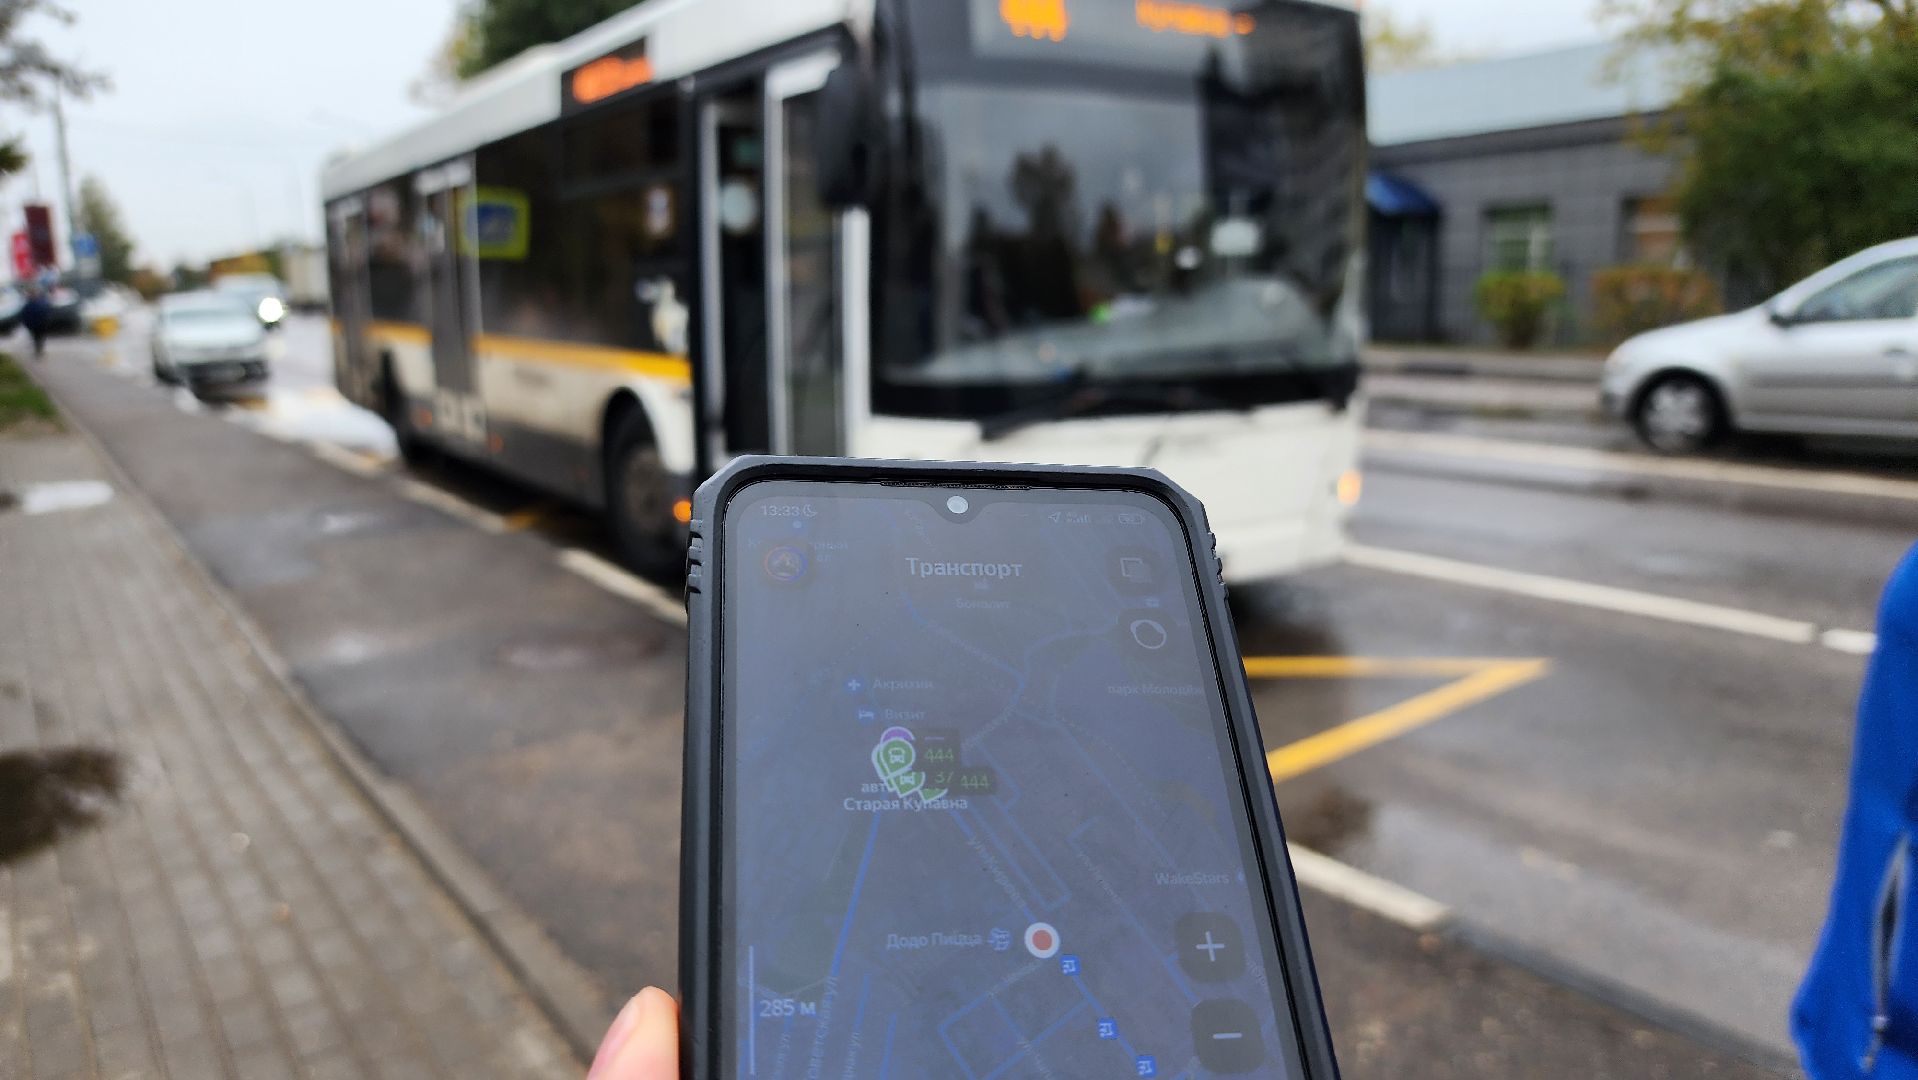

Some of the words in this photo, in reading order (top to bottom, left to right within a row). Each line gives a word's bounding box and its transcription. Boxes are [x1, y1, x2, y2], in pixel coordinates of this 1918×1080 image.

[760, 504, 801, 517] 13:33
[905, 557, 1023, 579] Транспорт
[884, 708, 926, 720] Визит
[924, 748, 955, 763] 444
[960, 773, 991, 790] 444
[843, 796, 901, 812] Старая
[903, 796, 969, 812] Купавна
[1154, 871, 1231, 885] WakeStars
[886, 933, 929, 949] Додо
[931, 931, 983, 947] Пицца
[759, 998, 796, 1018] 285
[800, 1001, 817, 1016] м
